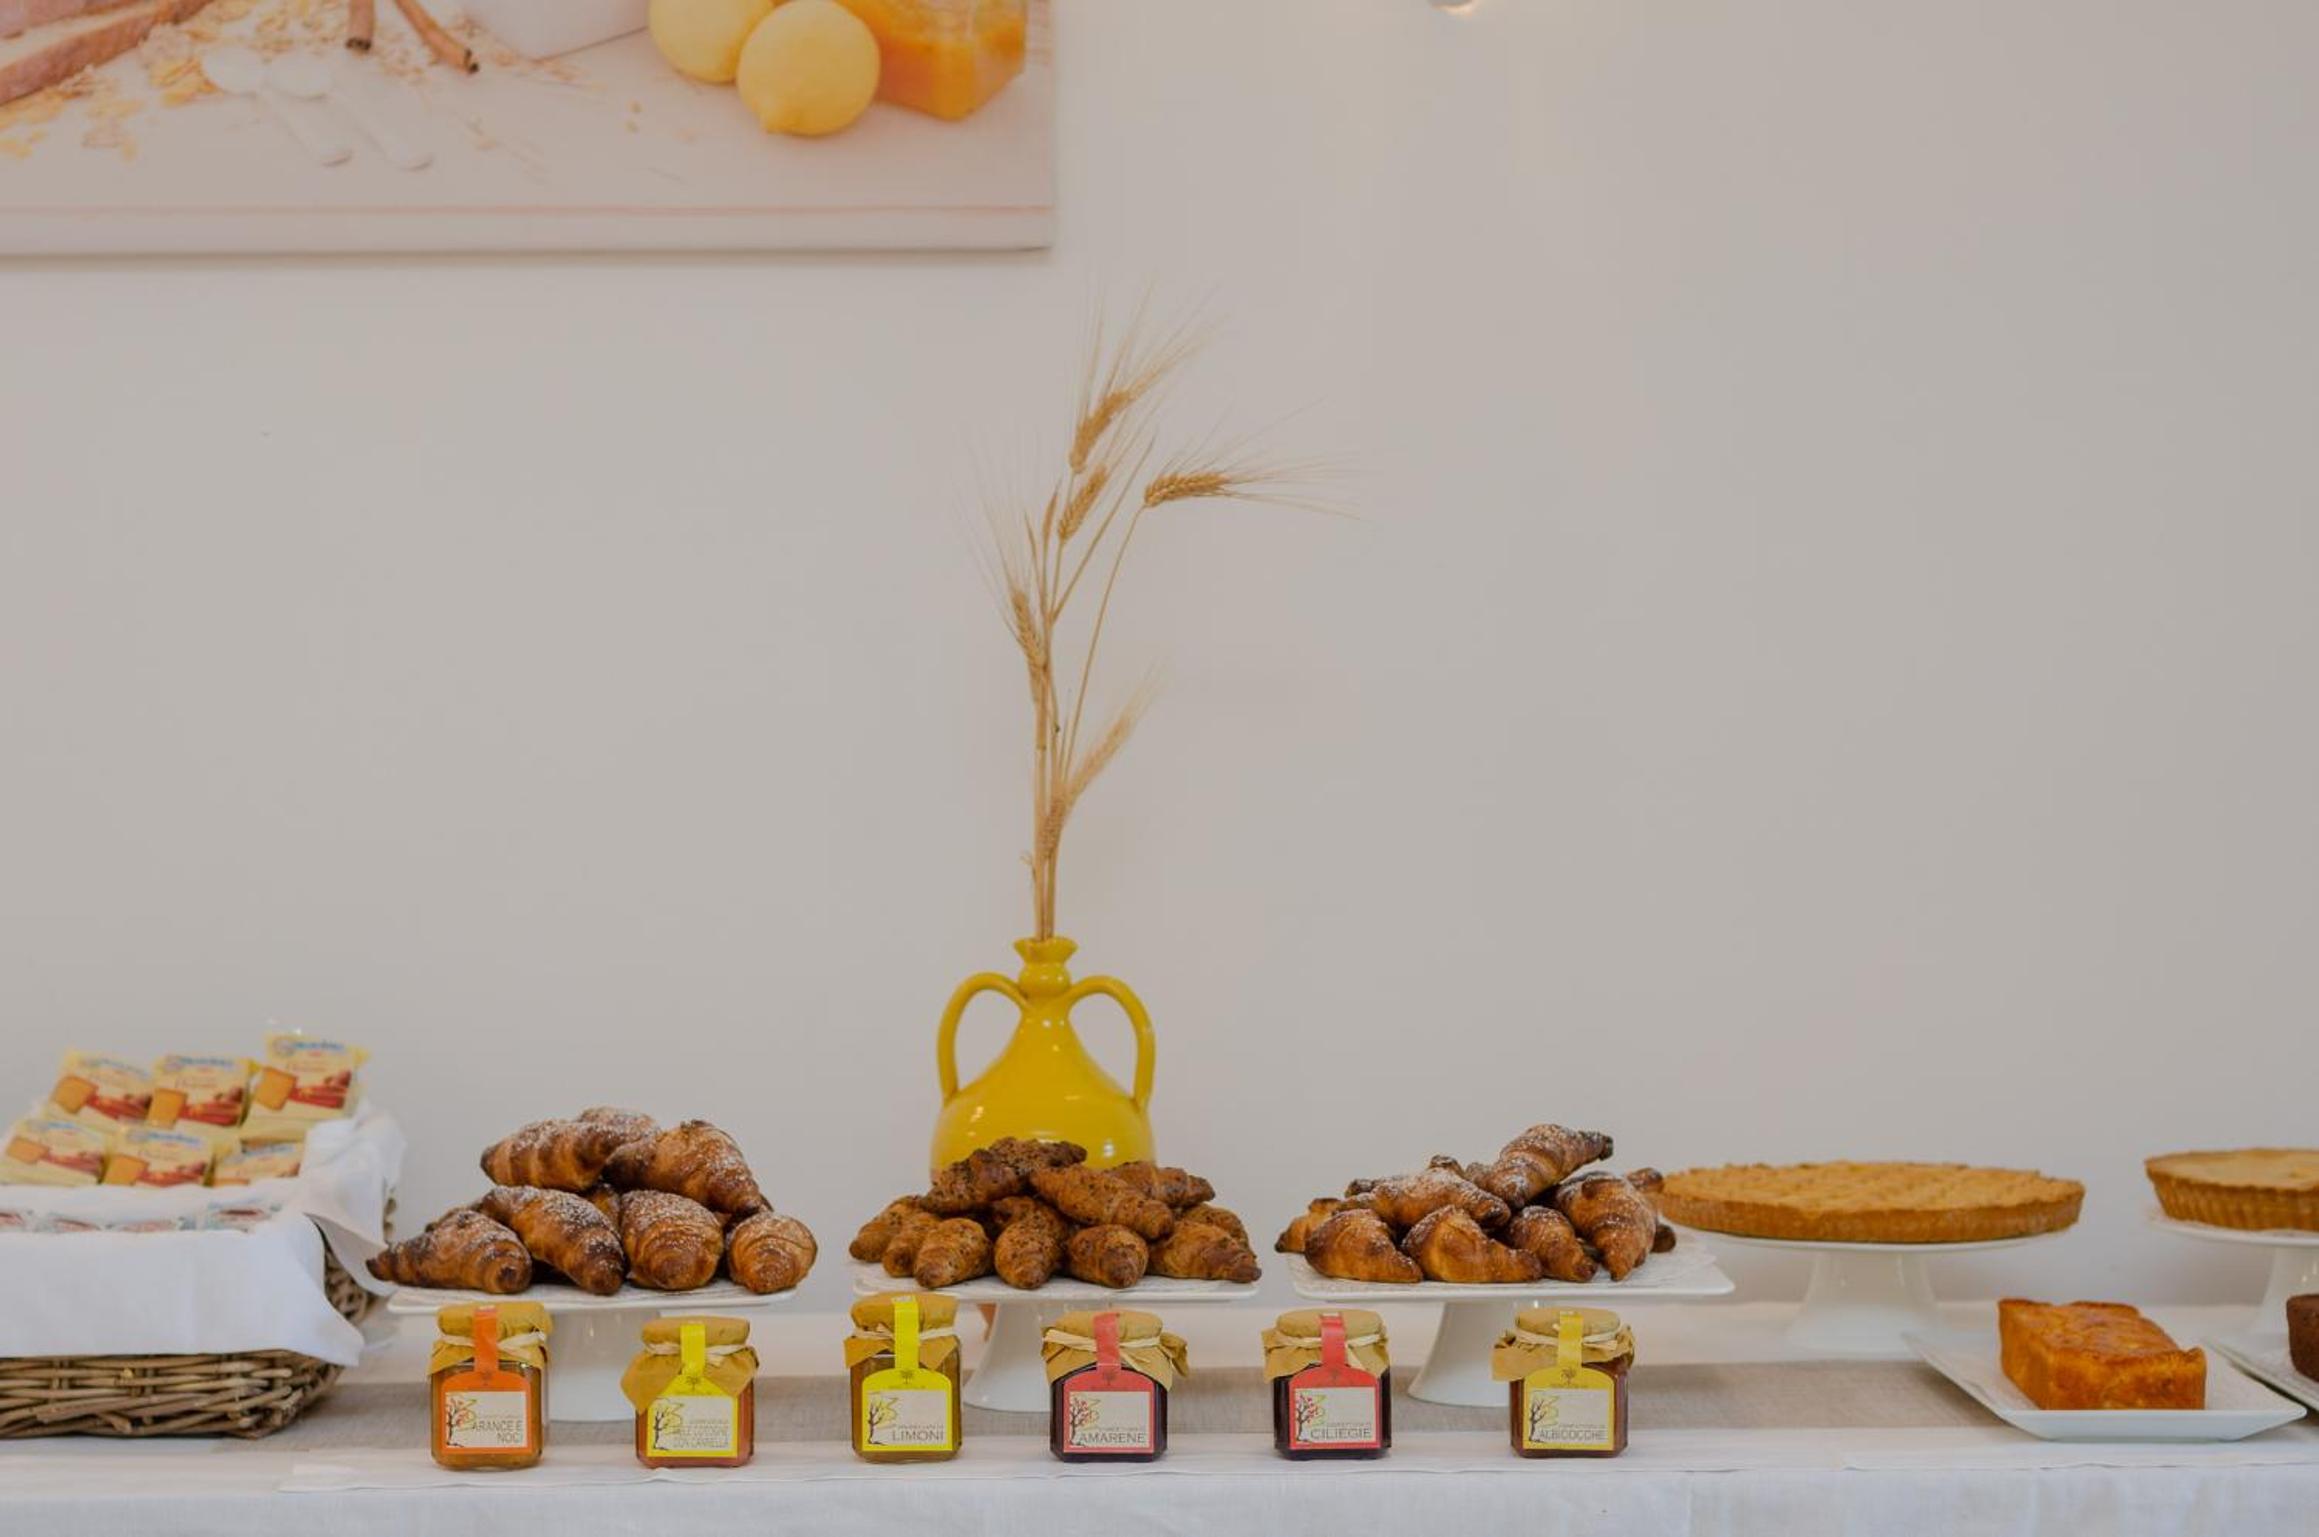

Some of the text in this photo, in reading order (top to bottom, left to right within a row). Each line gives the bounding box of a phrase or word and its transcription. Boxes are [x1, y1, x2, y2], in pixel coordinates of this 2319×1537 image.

[892, 1430, 944, 1441] LIMONI
[1079, 1432, 1146, 1443] AMARENE
[1310, 1428, 1372, 1440] CILIEGIE
